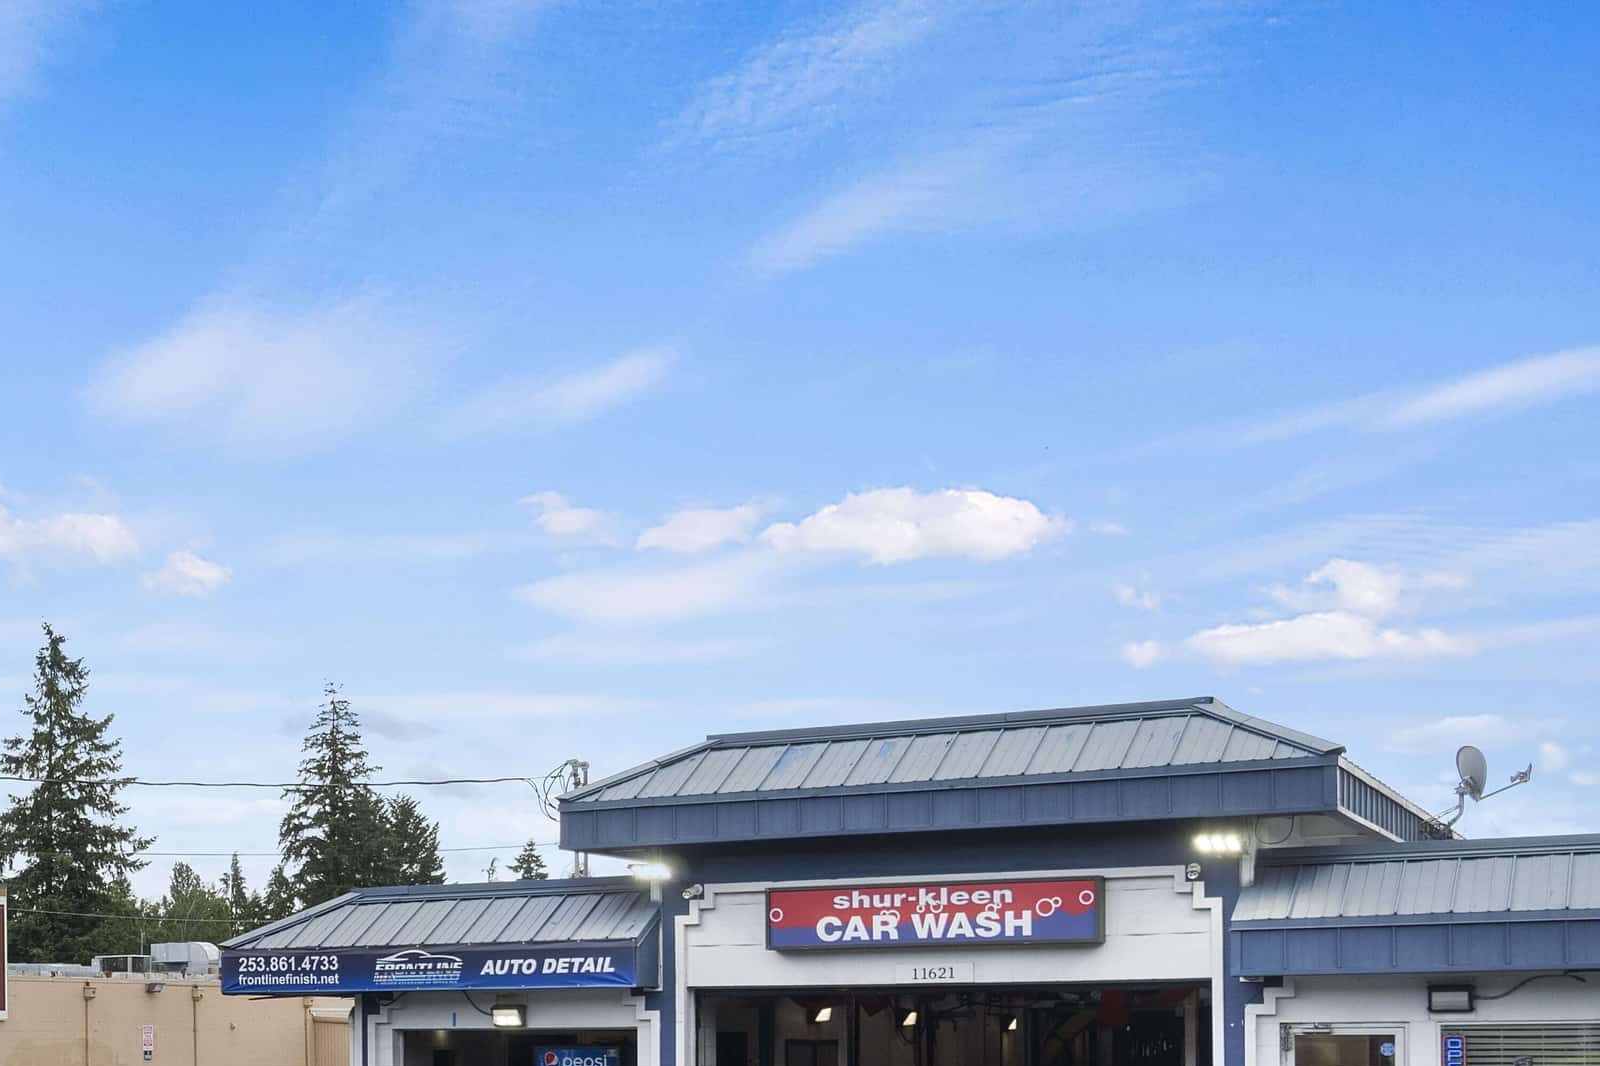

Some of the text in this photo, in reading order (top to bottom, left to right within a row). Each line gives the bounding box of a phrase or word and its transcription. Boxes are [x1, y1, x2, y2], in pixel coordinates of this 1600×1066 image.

[833, 888, 1013, 909] shur-kleen
[816, 910, 1033, 942] CAR WASH
[239, 955, 339, 972] 253.861.4733
[480, 956, 615, 975] AUTO DETAIL
[238, 973, 340, 986] frontlinefinish.net
[911, 967, 956, 981] 11621
